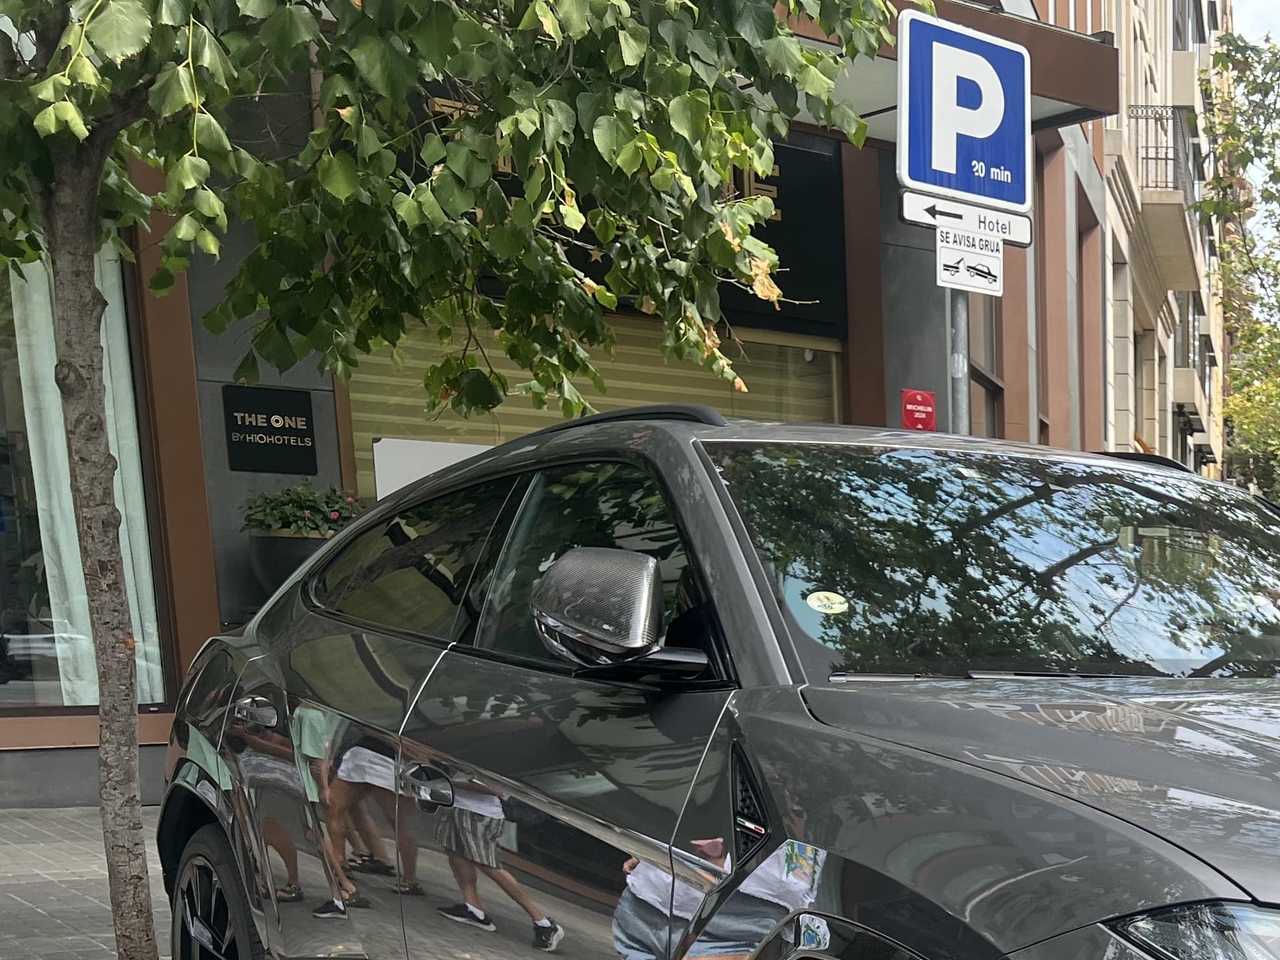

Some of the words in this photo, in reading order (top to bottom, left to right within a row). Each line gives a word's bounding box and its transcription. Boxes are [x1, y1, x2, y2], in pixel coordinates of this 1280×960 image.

[931, 41, 1005, 175] P
[971, 160, 985, 178] 20
[990, 166, 1012, 183] min
[978, 214, 1011, 235] Hotel
[940, 230, 950, 244] SE
[952, 232, 977, 251] AVISA
[979, 238, 1000, 254] GRUA
[233, 412, 267, 427] THE
[270, 414, 307, 430] ONE
[231, 432, 244, 442] BY
